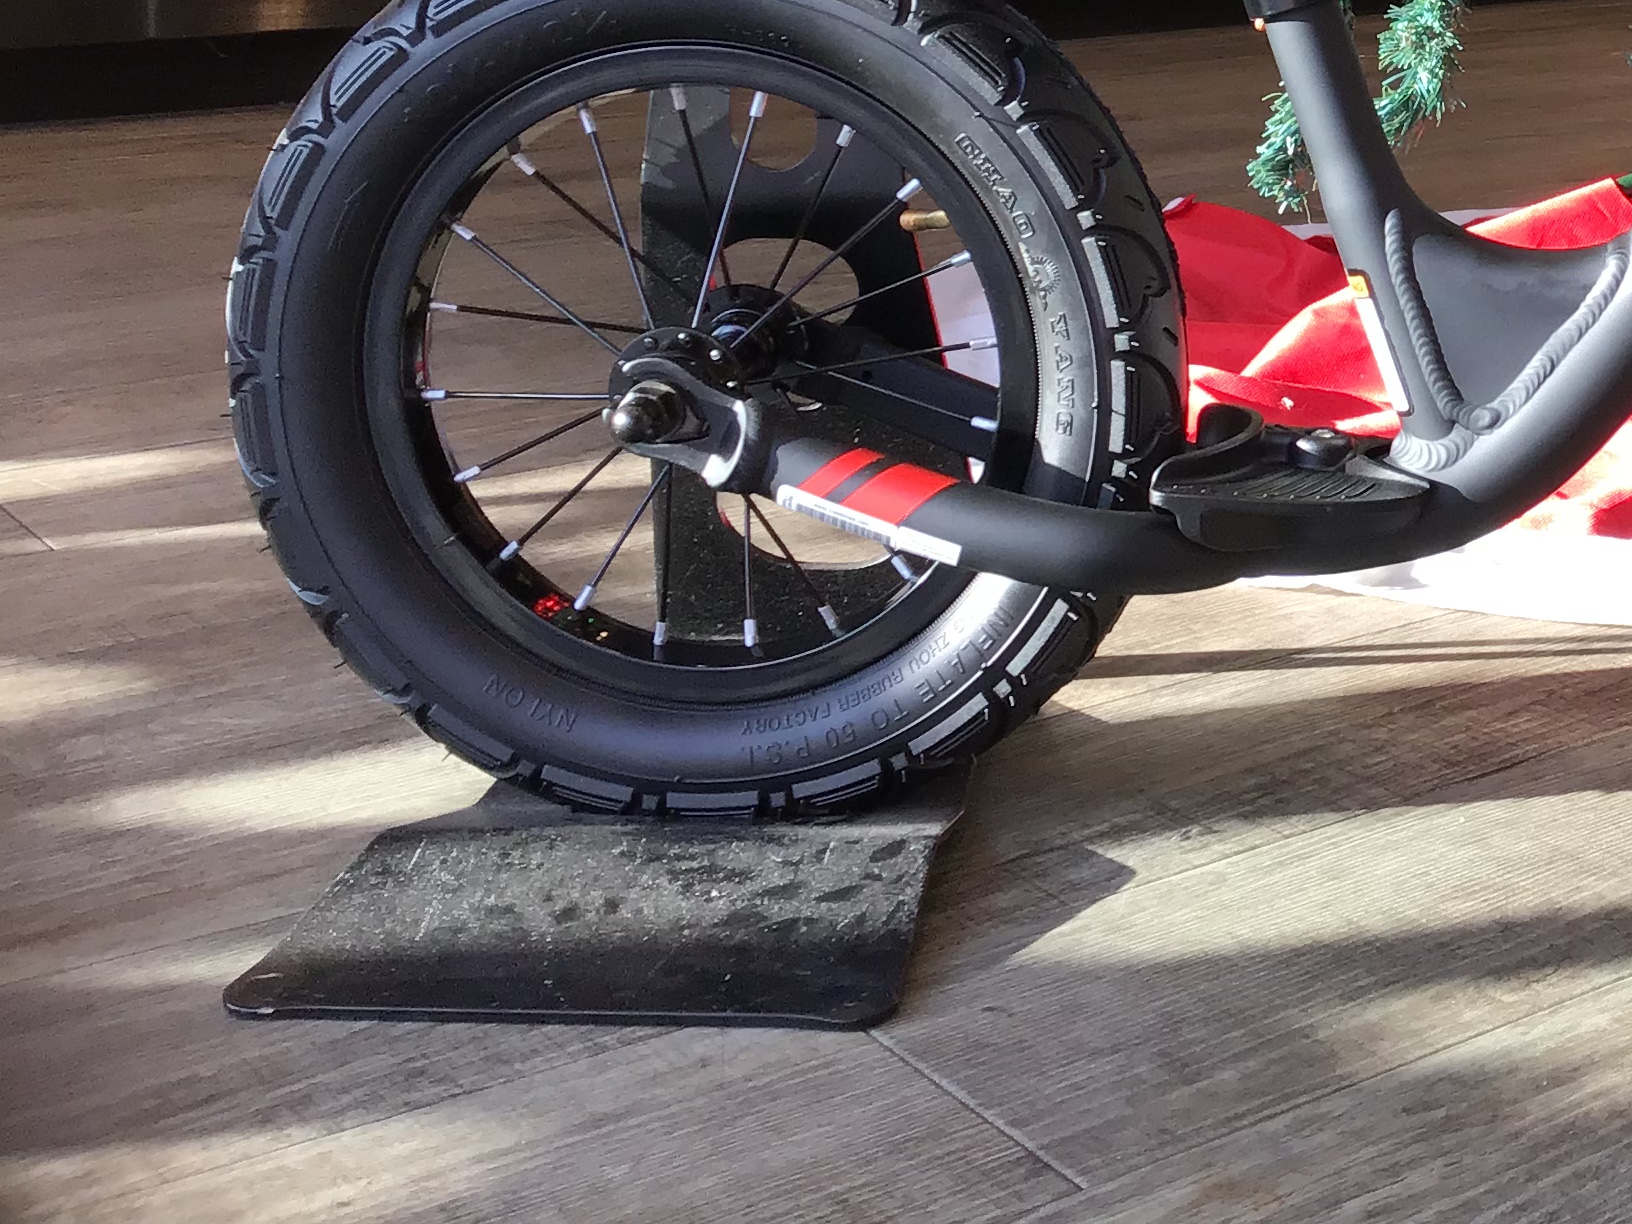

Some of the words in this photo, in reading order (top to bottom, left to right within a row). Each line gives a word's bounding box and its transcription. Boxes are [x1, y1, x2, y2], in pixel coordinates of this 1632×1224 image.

[839, 668, 905, 711] RUBBER
[740, 702, 831, 736] FACTORY
[871, 697, 911, 730] TO
[824, 727, 858, 749] 50
